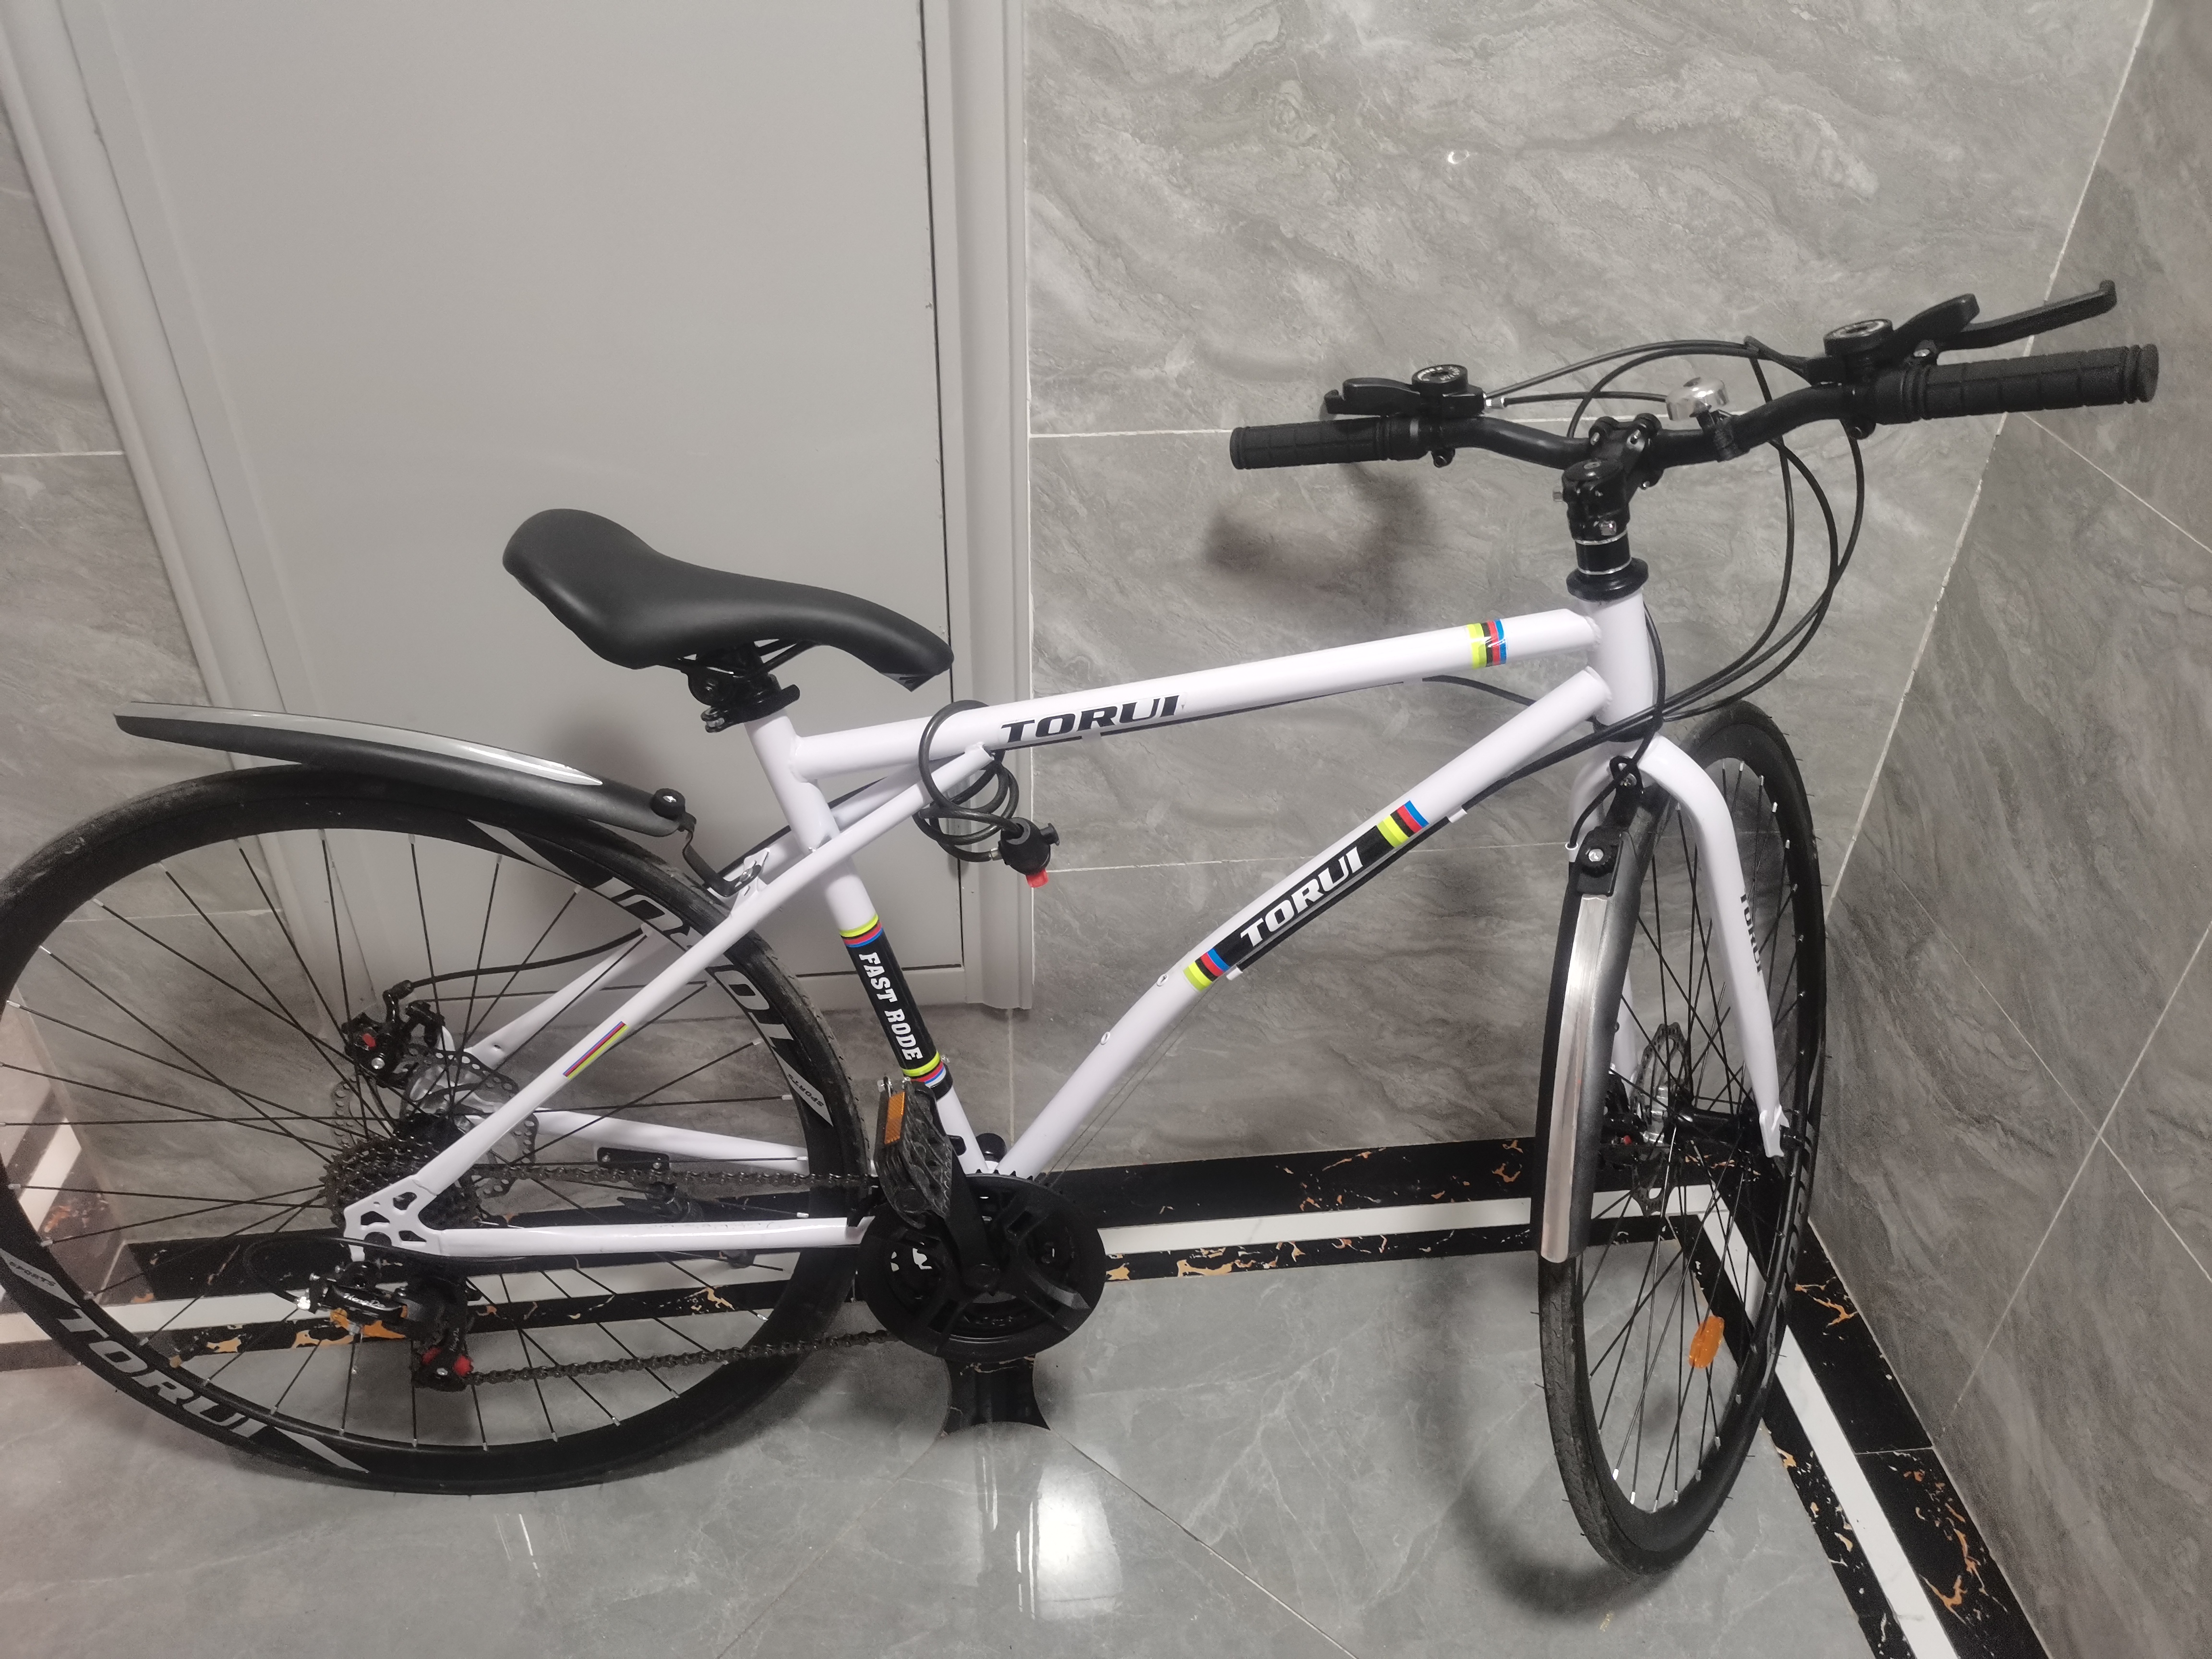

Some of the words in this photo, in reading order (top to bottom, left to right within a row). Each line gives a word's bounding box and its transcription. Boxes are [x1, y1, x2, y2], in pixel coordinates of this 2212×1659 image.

[1001, 695, 1179, 743] TORUI
[1240, 846, 1363, 947] TORUI
[859, 952, 898, 1003] FAST
[884, 1009, 923, 1060] RODE
[57, 1308, 271, 1438] TORUI
